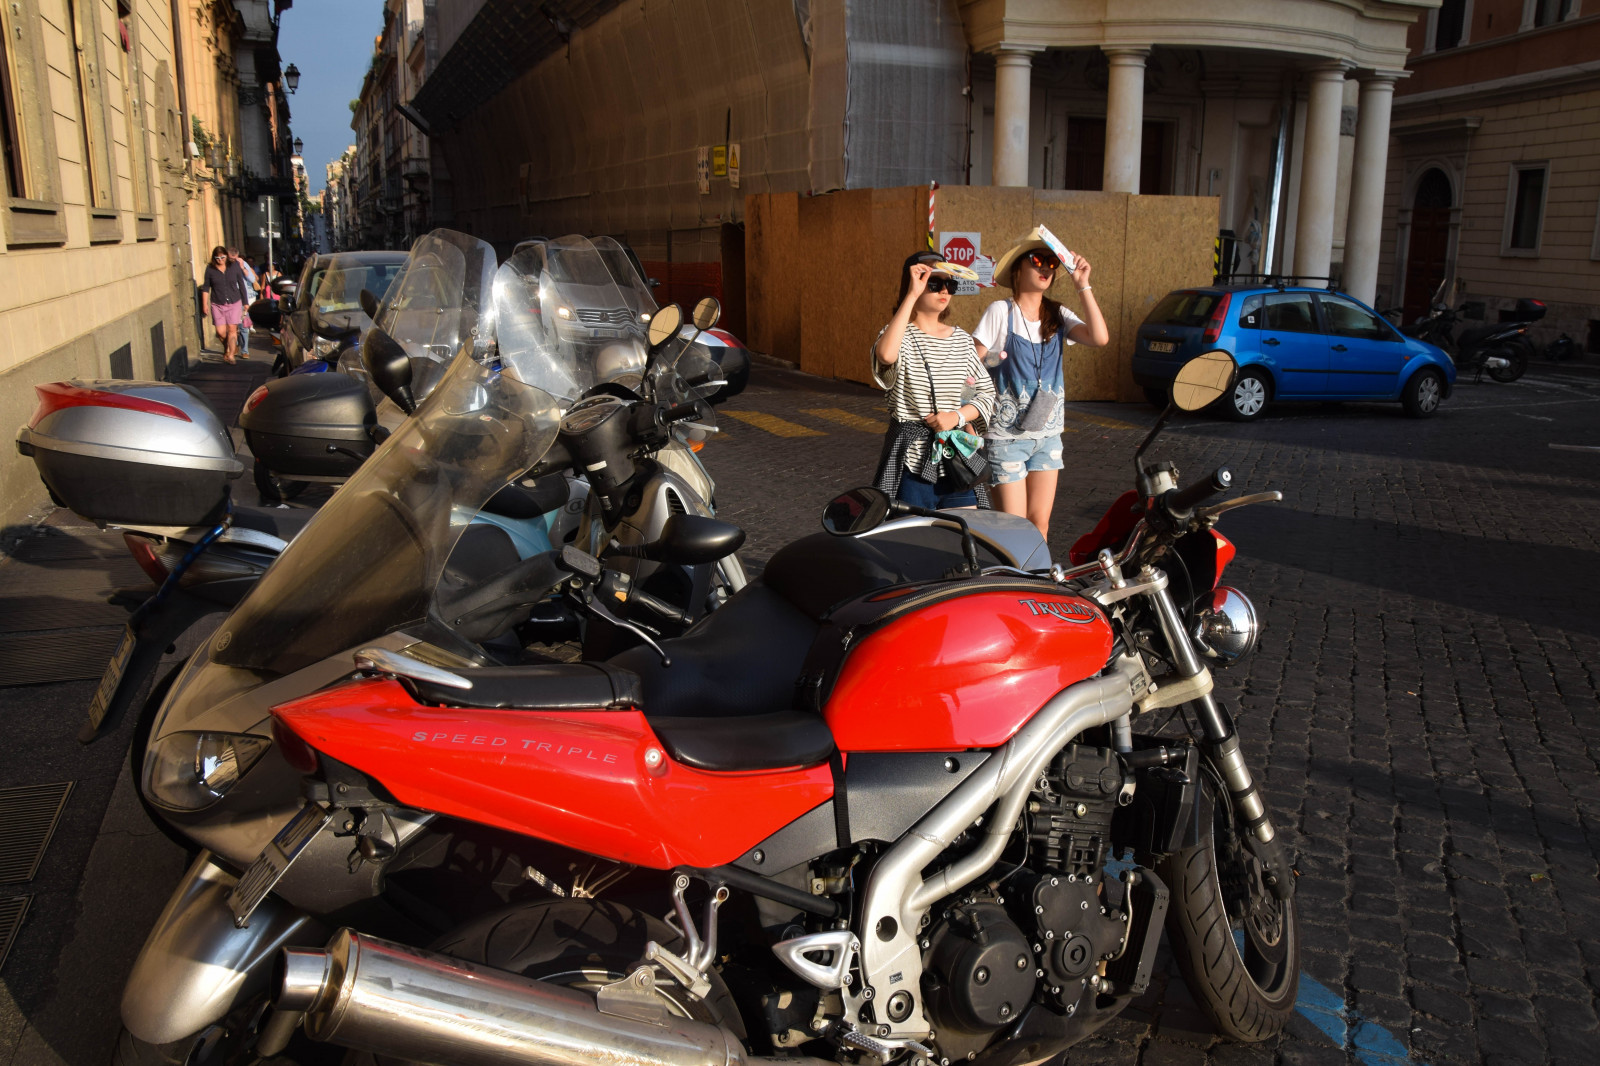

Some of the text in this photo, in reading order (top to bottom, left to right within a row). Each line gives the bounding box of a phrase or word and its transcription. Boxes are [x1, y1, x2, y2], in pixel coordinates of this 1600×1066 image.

[945, 247, 974, 261] STOP
[412, 731, 618, 764] SPEED TRIPLE
